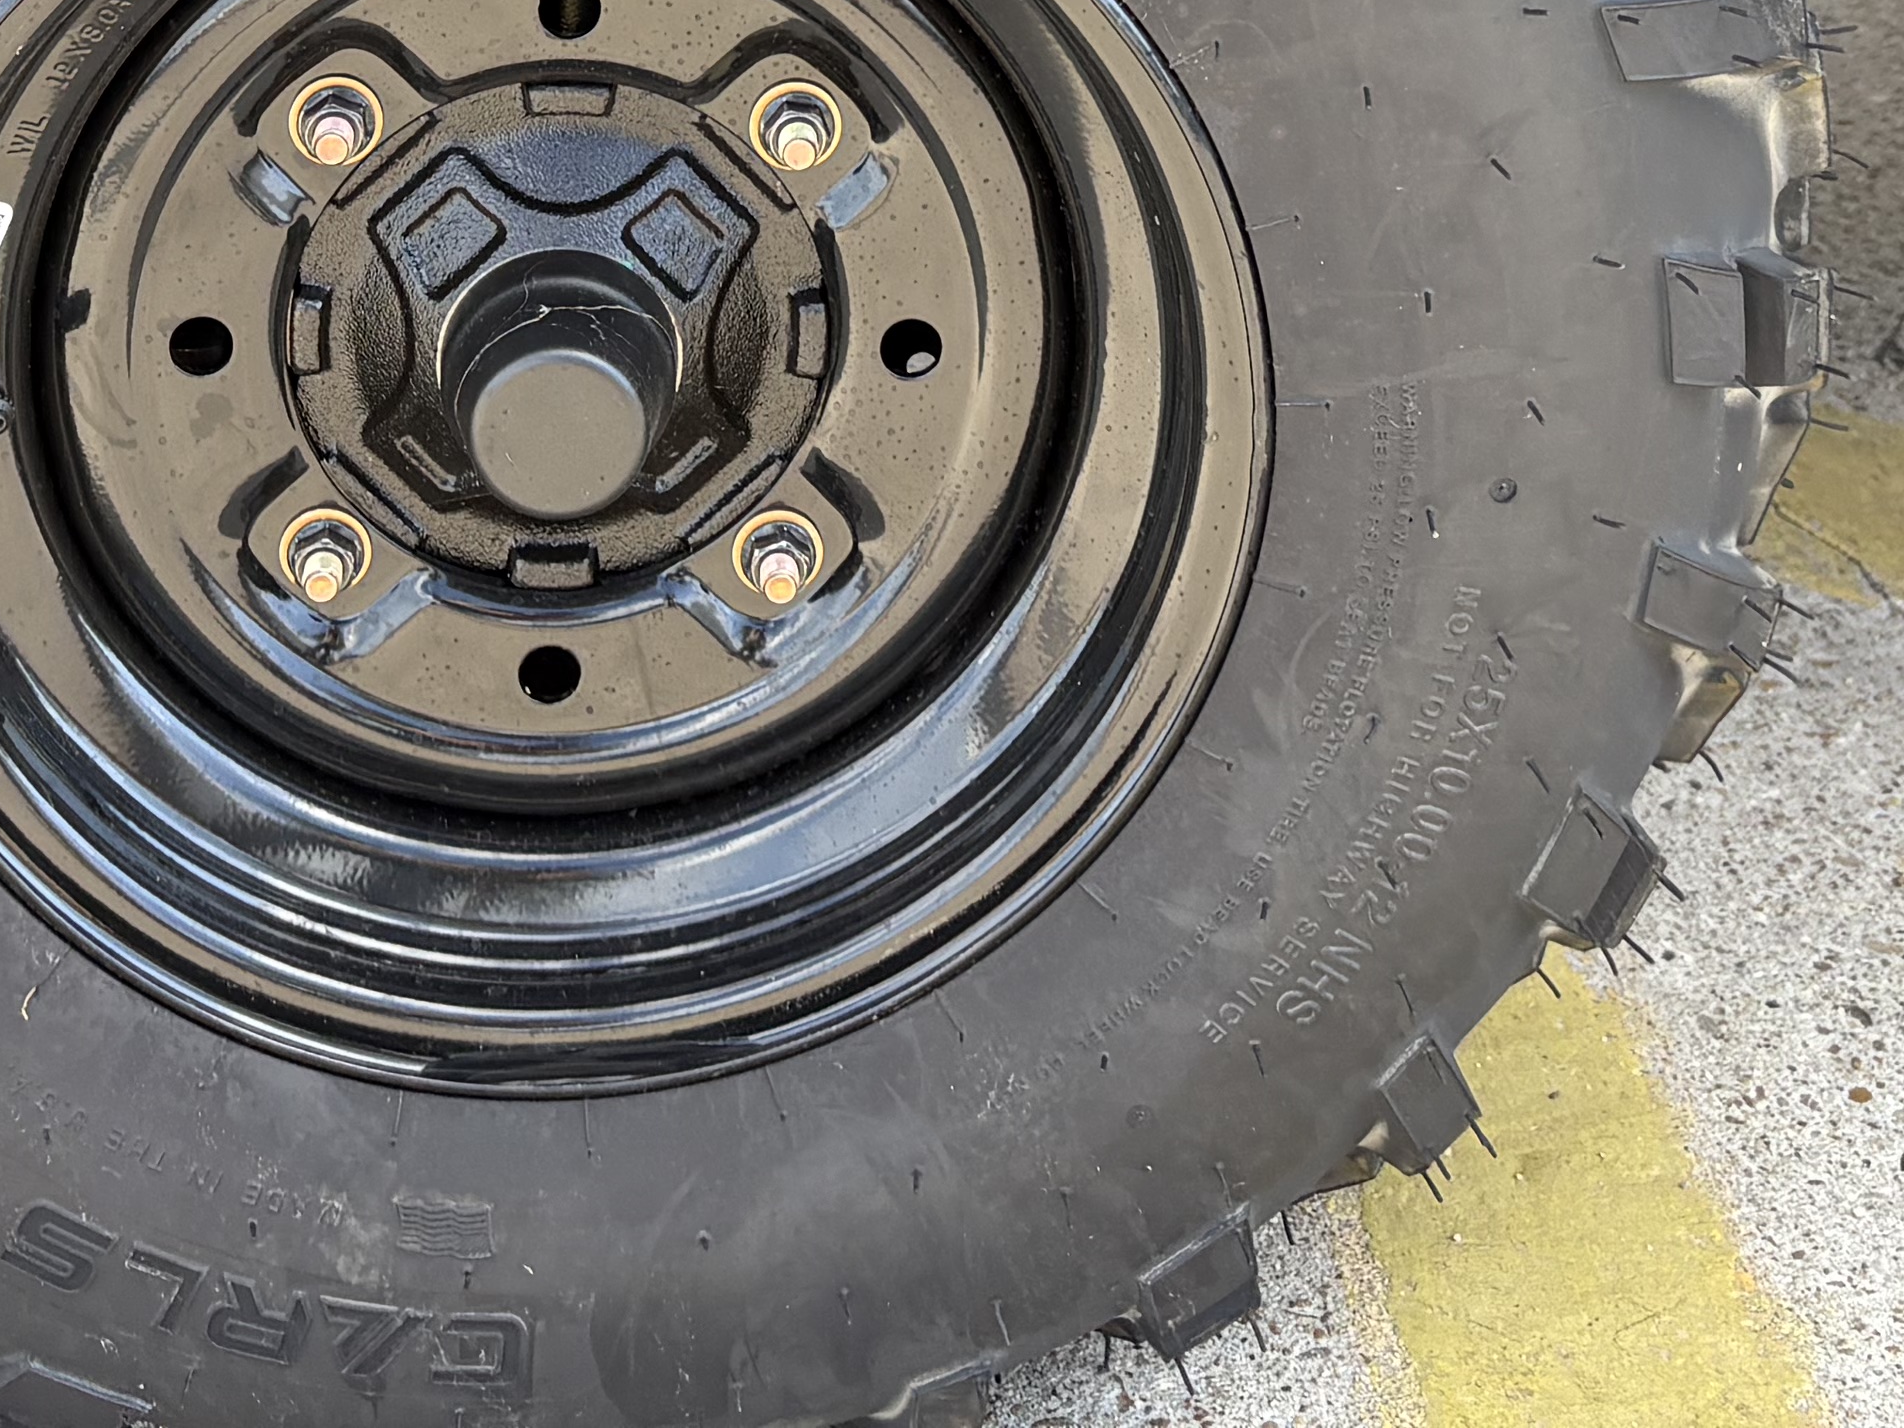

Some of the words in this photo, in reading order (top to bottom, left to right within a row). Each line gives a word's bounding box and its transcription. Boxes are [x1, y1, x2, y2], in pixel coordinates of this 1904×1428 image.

[1311, 751, 1425, 914] HIGHWAY
[1193, 911, 1324, 1049] SERVICE
[1265, 921, 1381, 1039] NHS
